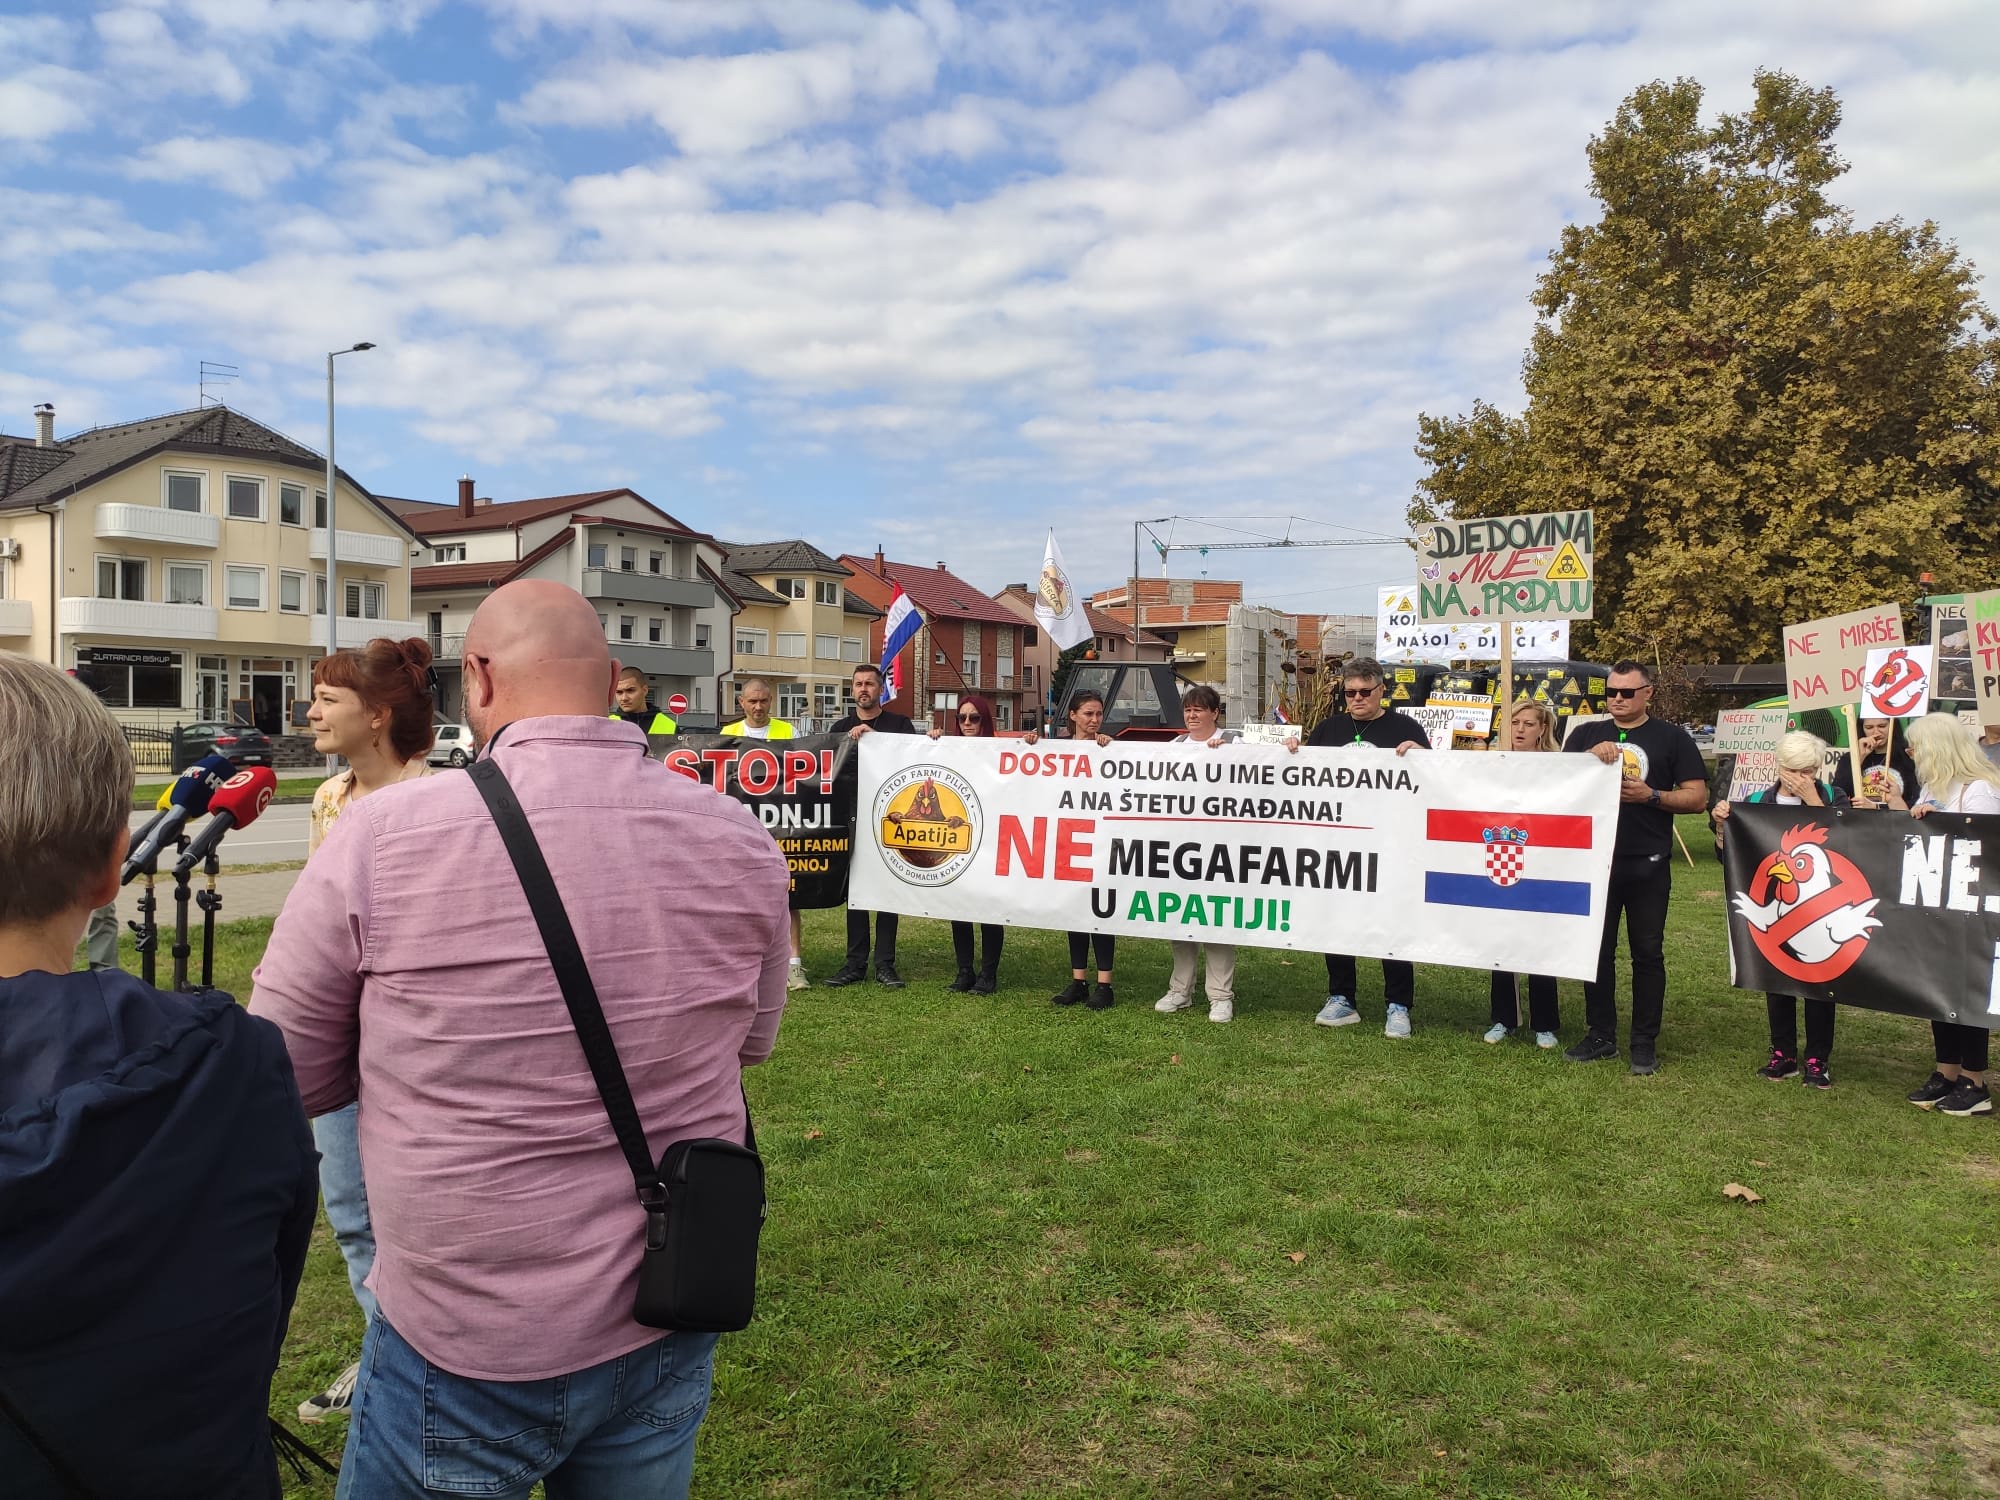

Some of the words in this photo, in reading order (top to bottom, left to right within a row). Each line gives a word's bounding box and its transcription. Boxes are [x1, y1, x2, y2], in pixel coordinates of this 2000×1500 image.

[1427, 511, 1592, 558] DJEDOVINA
[1456, 547, 1553, 584] NIJE
[1421, 582, 1468, 618] NA
[1481, 579, 1592, 615] PRODAJU
[1390, 615, 1416, 626] KOJ
[1788, 633, 1820, 657] NE
[1839, 616, 1900, 649] MIRIŠE
[1976, 622, 2000, 647] KU
[1396, 632, 1449, 647] NAŠOJ
[1792, 676, 1829, 699] NA
[1842, 666, 1866, 692] DO
[1414, 708, 1454, 721] HODAMO
[1733, 725, 1765, 736] UZETI
[1761, 714, 1783, 724] NAM
[1718, 737, 1777, 751] BUDUĆNOS
[664, 749, 834, 795] STOP!
[883, 775, 908, 797] STOP
[911, 769, 942, 779] FARMI
[945, 773, 971, 801] PILIĆA
[999, 751, 1092, 779] DOSTA
[1100, 759, 1198, 783] ODLUKA
[1205, 763, 1221, 783] U
[1230, 764, 1275, 785] IME
[1282, 765, 1420, 794] GRAĐANA,
[1059, 790, 1074, 809] A
[1080, 791, 1113, 811] NA
[1119, 788, 1196, 815] ŠTETU
[1202, 797, 1342, 822] GRAĐANA!
[805, 838, 848, 851] FARMI
[894, 824, 958, 847] Apatija
[995, 814, 1096, 882] NE
[1108, 838, 1378, 893] MEGAFARMI
[1091, 888, 1117, 918] U
[1127, 890, 1291, 932] APATIJI!
